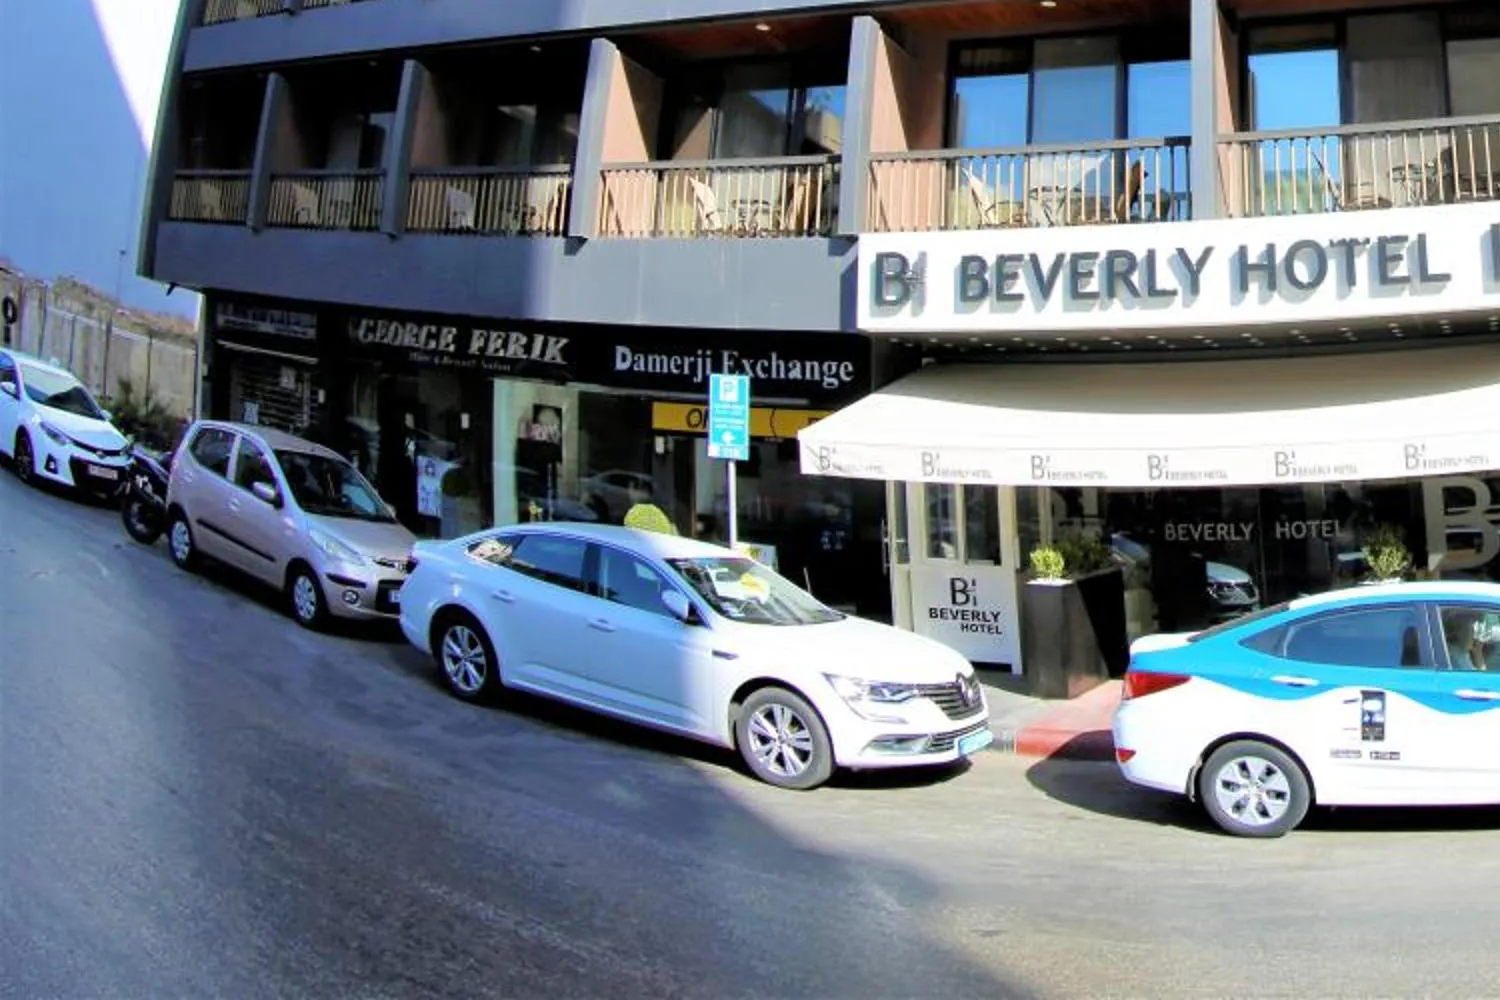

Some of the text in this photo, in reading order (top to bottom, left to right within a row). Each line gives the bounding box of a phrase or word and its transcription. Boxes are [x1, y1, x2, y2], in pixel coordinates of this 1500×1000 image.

[960, 246, 1215, 302] BEVERLY
[1238, 233, 1452, 292] HOTEL
[358, 318, 458, 352] GEORGE
[468, 328, 570, 366] FERIK
[614, 345, 855, 389] Damerji Exchange
[1165, 519, 1347, 543] BEVERLY HOTEL
[929, 607, 1001, 622] BEVERLY
[960, 623, 1002, 635] HOTEL
